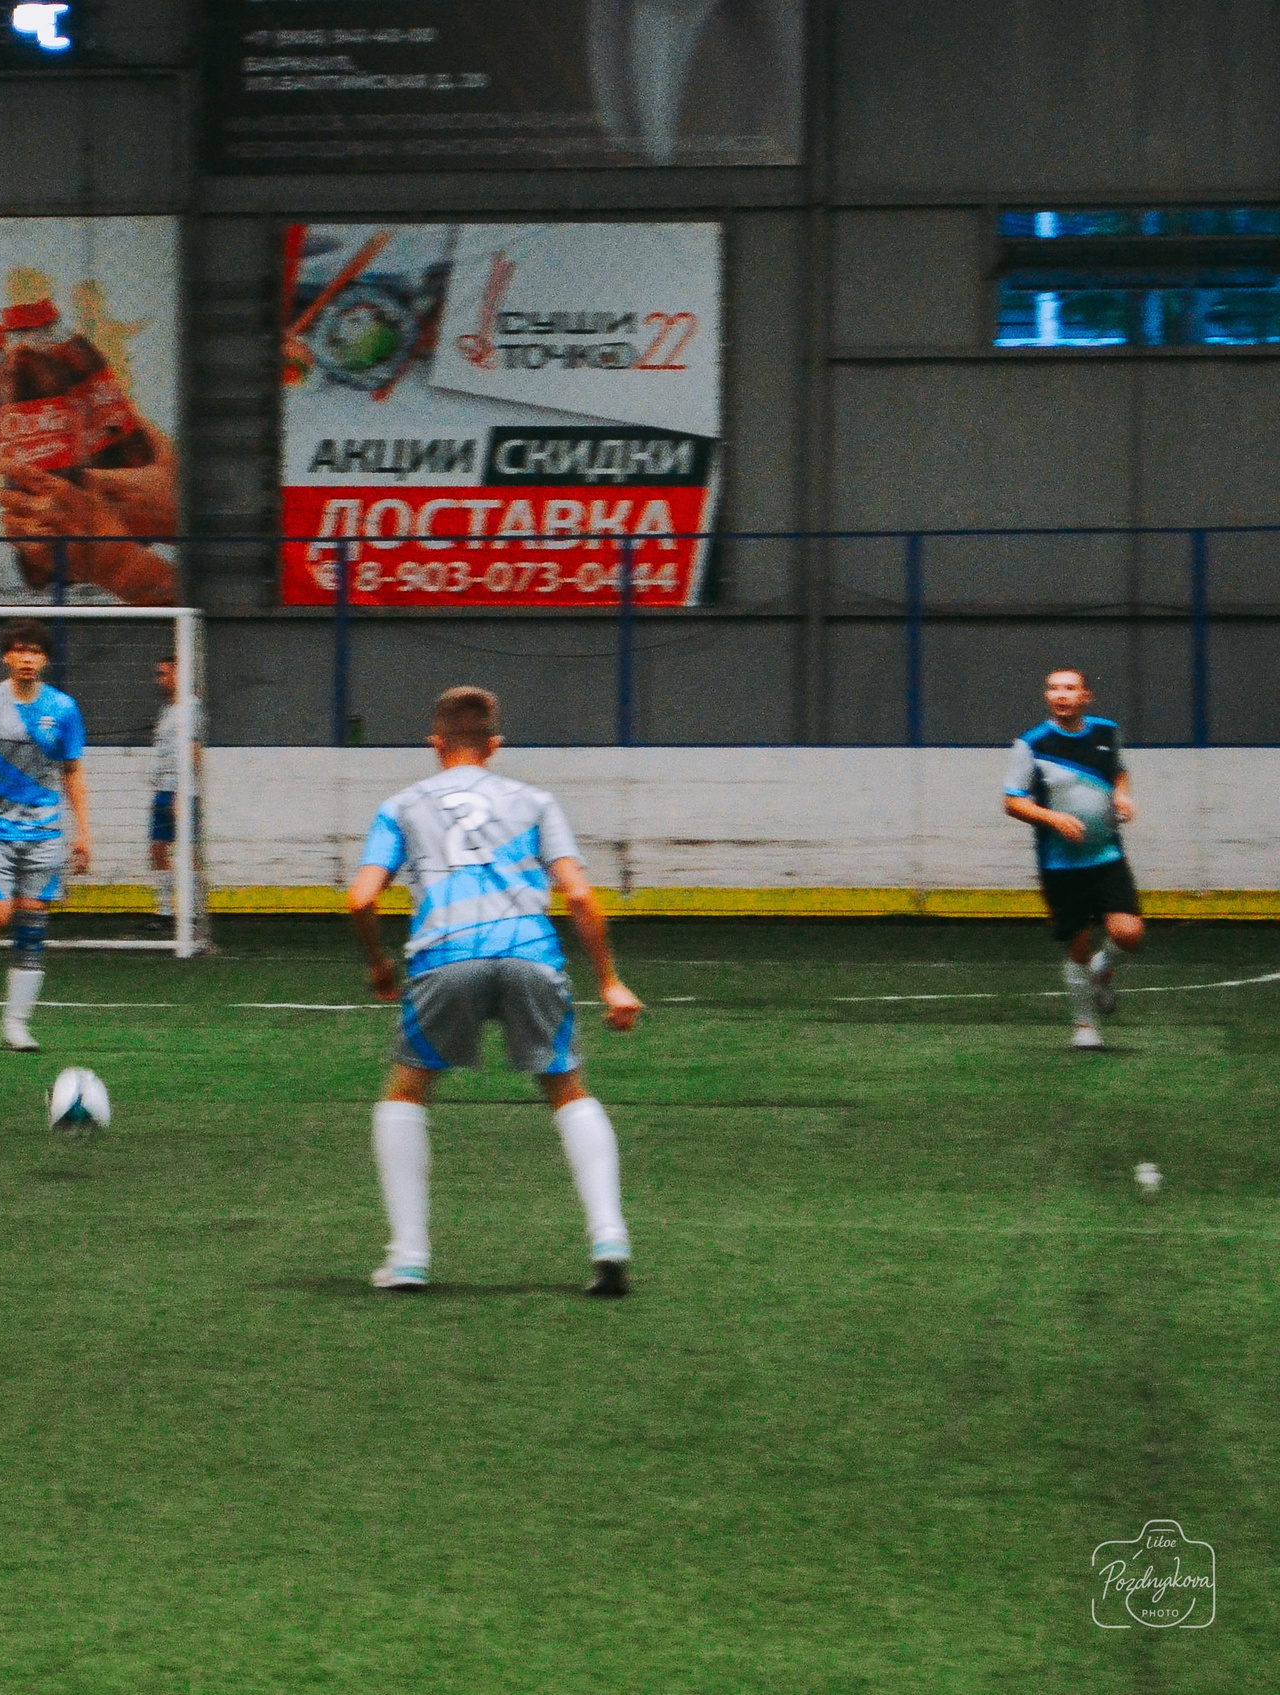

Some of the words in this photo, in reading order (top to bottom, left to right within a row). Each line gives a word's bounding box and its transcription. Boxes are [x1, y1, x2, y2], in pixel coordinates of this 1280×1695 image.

[306, 438, 478, 482] АКЦИИ
[494, 438, 696, 483] СКИДКИ
[306, 498, 680, 562] ДОСТАВКА
[354, 561, 680, 593] 8-903-073-0444
[439, 791, 495, 866] 2
